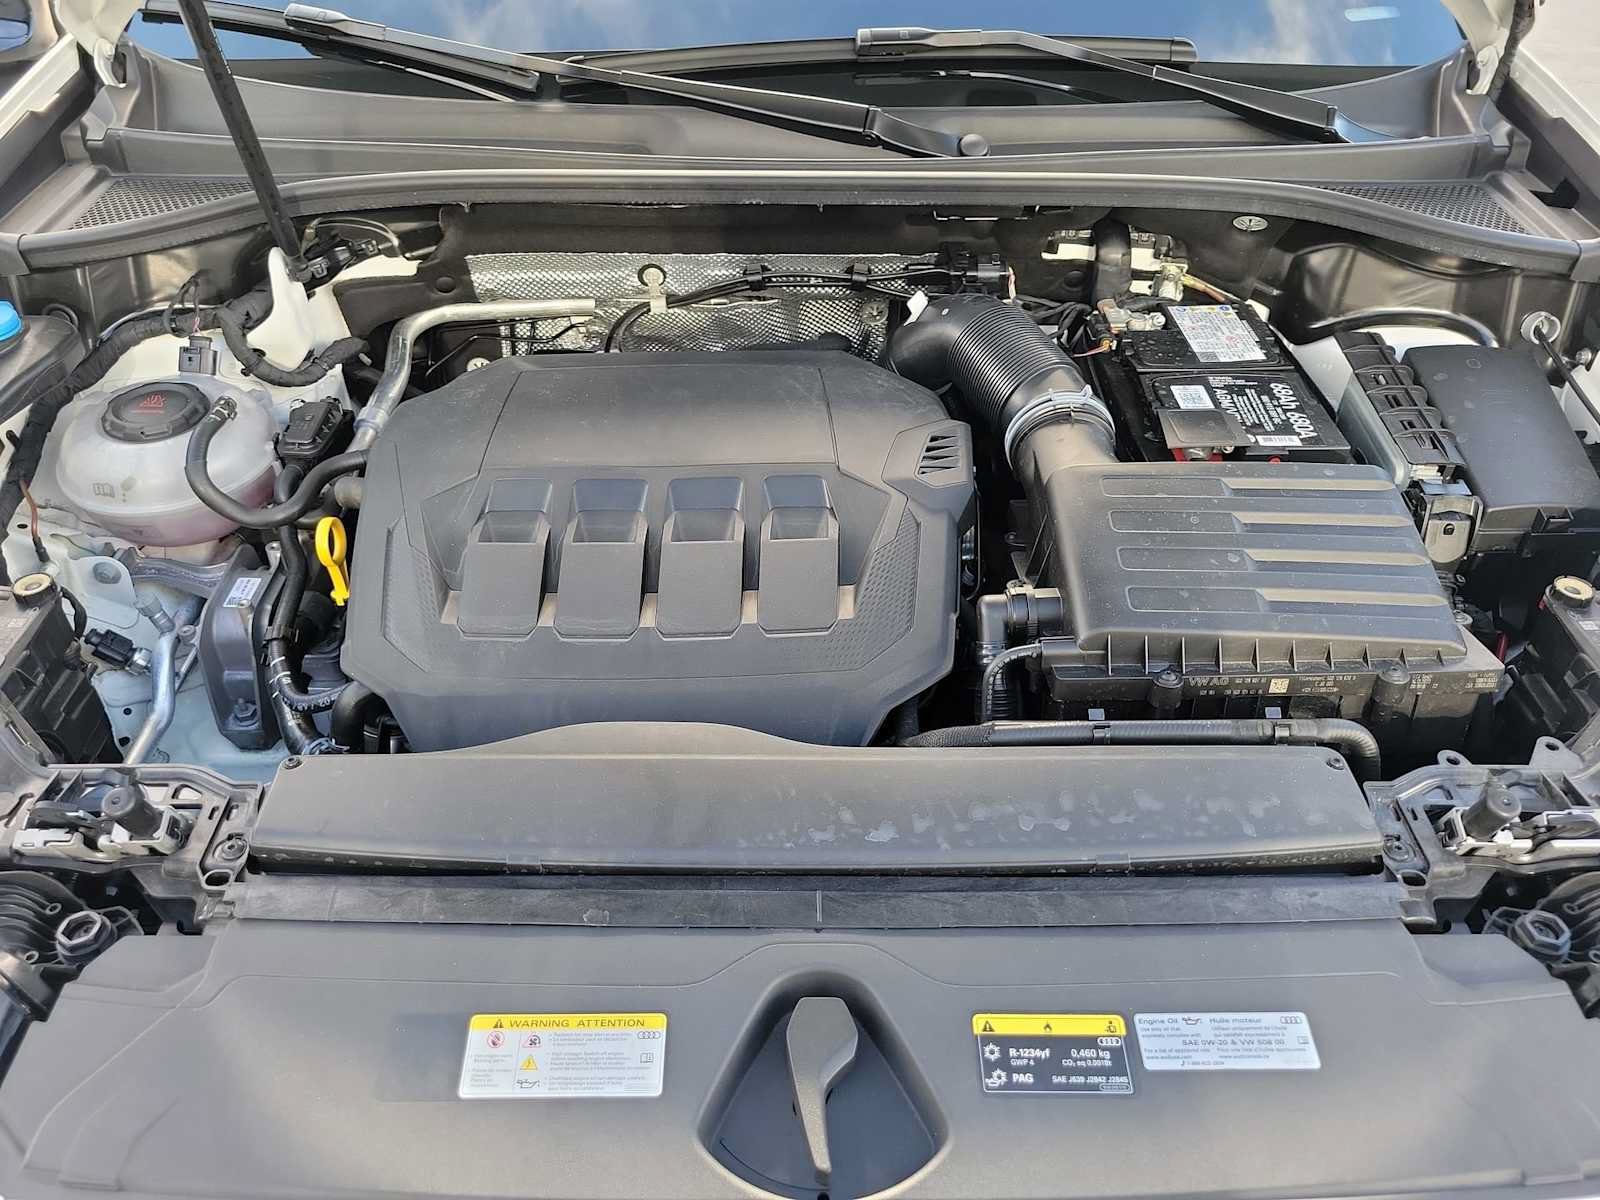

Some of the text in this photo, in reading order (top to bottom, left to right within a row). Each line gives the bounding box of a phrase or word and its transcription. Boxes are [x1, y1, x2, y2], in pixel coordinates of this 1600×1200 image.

[1270, 383, 1300, 409] 68Ah
[1286, 411, 1317, 439] 680A
[509, 1019, 646, 1028] WARNING ATTENTION
[1138, 1018, 1165, 1026] Engine
[1008, 1047, 1051, 1060] R-1234yf
[1098, 1048, 1111, 1060] kg
[1012, 1072, 1034, 1083] PAG
[1051, 1075, 1068, 1083] SAE
